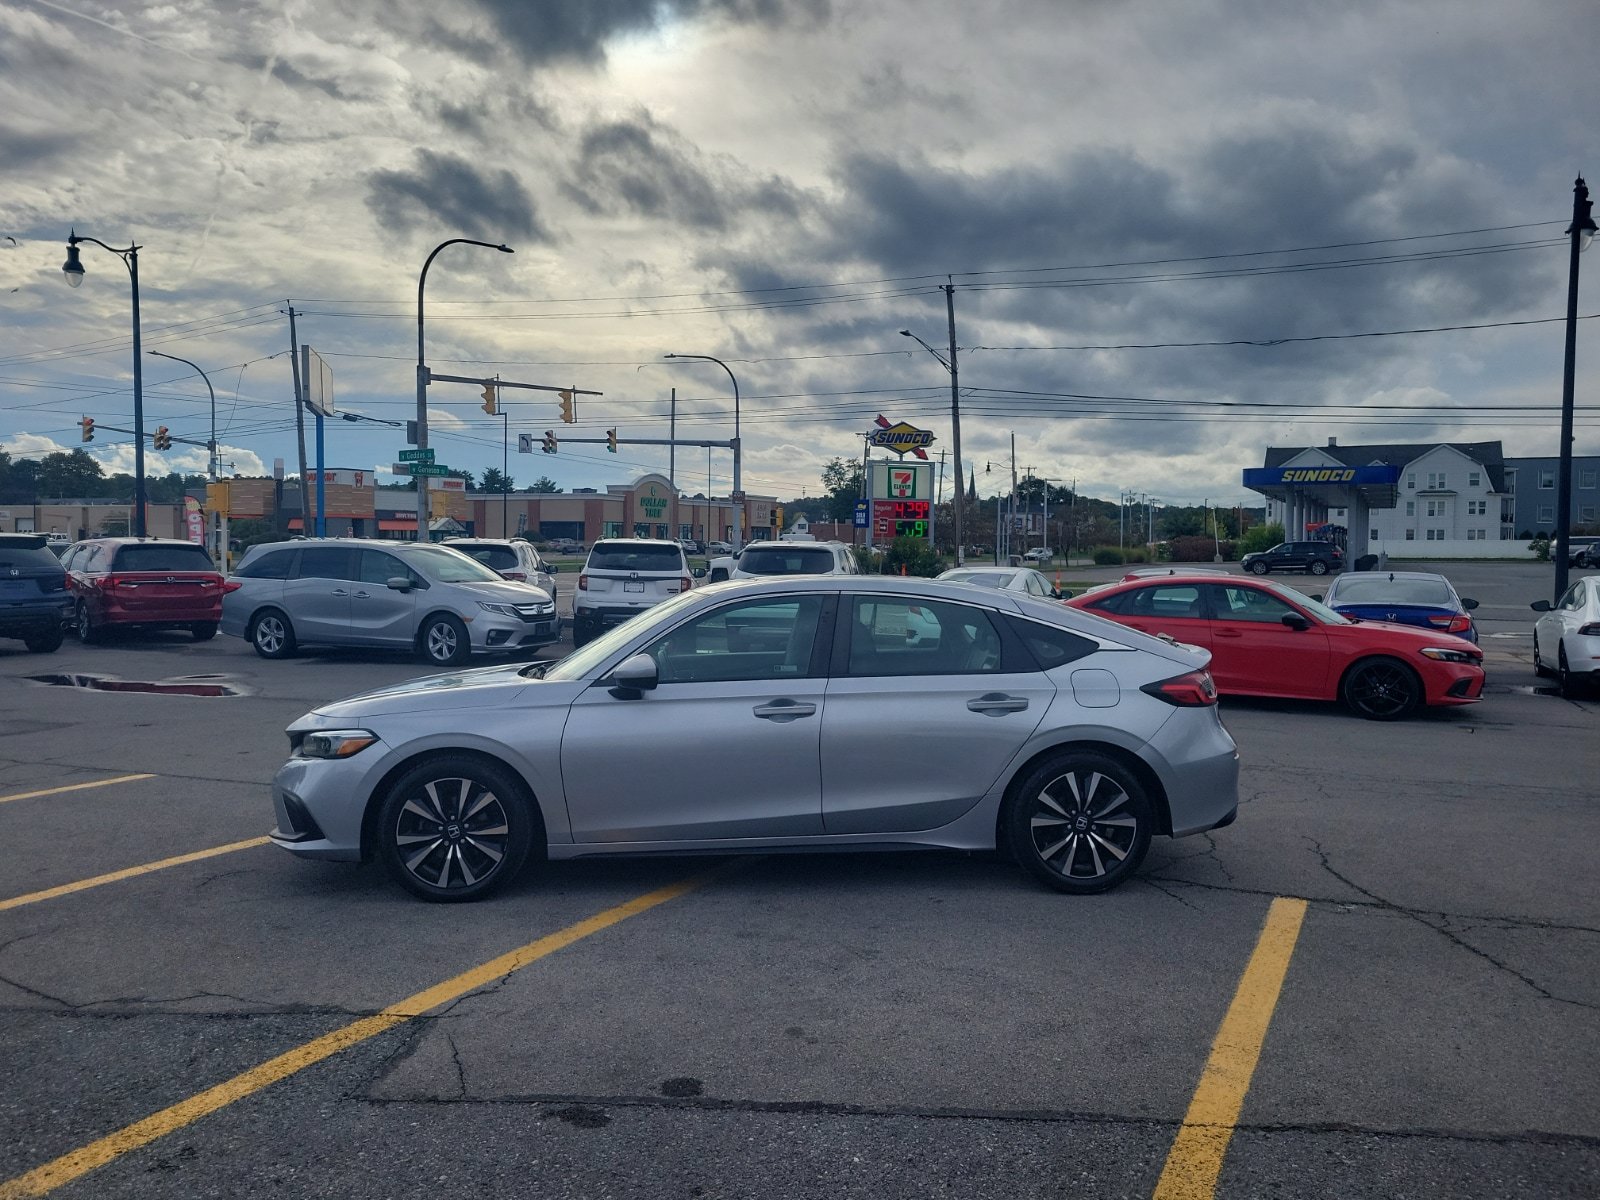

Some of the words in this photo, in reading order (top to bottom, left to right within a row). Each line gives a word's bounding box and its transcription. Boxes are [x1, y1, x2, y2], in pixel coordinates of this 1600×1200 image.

[877, 432, 931, 444] SUNOCO
[1281, 470, 1356, 482] SUNOCO
[640, 497, 667, 508] DOLLAR
[645, 508, 661, 518] TREE
